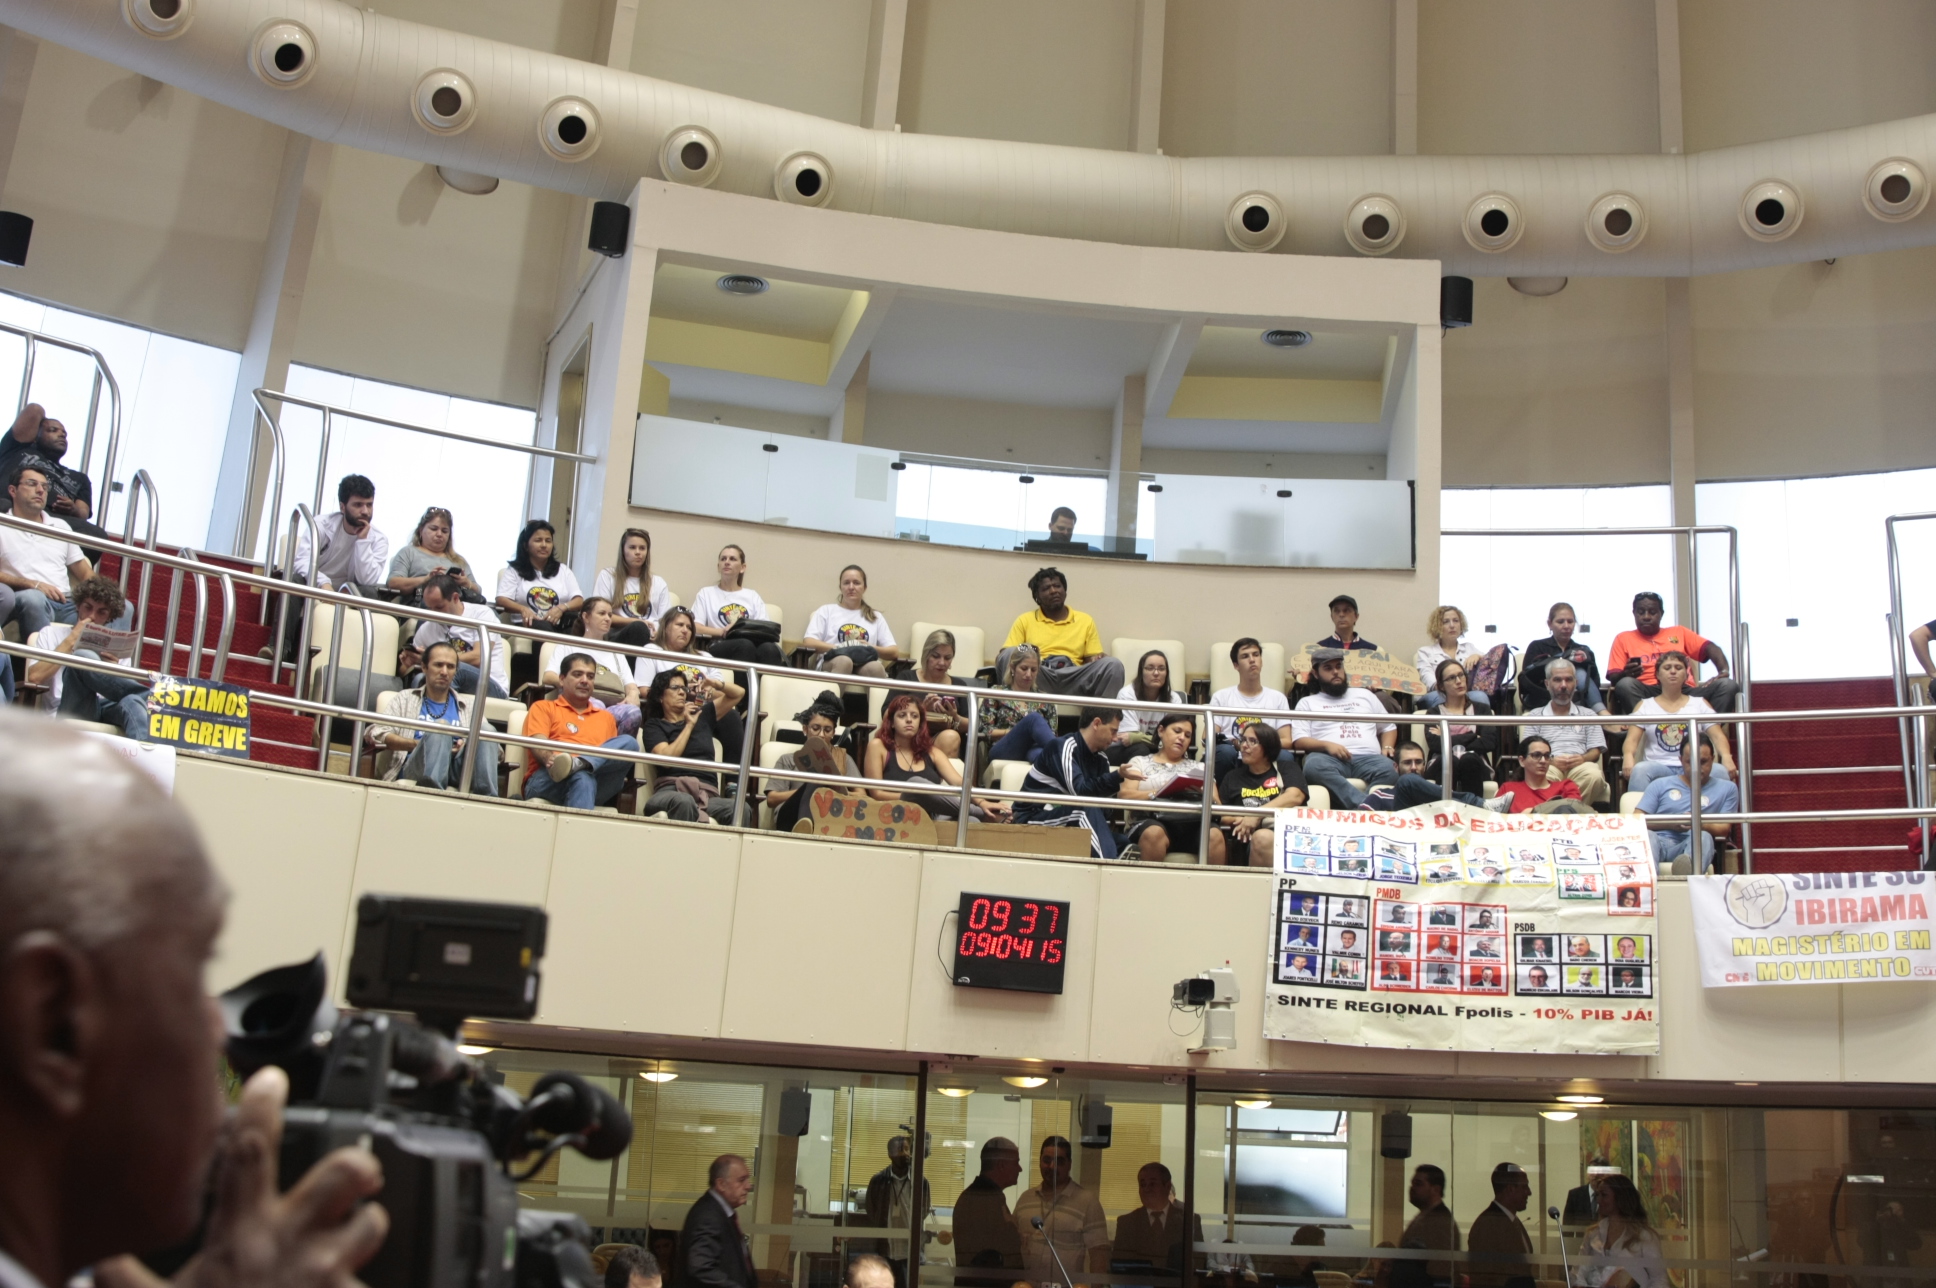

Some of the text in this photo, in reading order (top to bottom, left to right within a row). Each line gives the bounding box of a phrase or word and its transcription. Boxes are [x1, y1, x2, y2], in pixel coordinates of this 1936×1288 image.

[153, 682, 248, 719] ESTAMOS
[149, 714, 247, 751] EM GREVE
[814, 789, 922, 826] VOTE COM
[1296, 808, 1624, 835] INIMIGOS DA EDUCAÇÃO
[1279, 878, 1297, 890] PP
[1376, 887, 1401, 900] PMDB
[1793, 871, 1877, 890] SINTE
[1795, 894, 1928, 925] IBIRAMA
[1514, 922, 1535, 932] PSDB
[1732, 930, 1931, 956] MAGISTÉRIO EM
[1756, 956, 1911, 982] MOVIMENTO
[1277, 994, 1338, 1010] SINTE
[1345, 1000, 1448, 1016] REGIONAL
[1455, 1006, 1513, 1020] Fpolis
[1533, 1008, 1574, 1020] 10%
[1581, 1009, 1615, 1021] PIB
[1621, 1008, 1653, 1021] JÁ!
